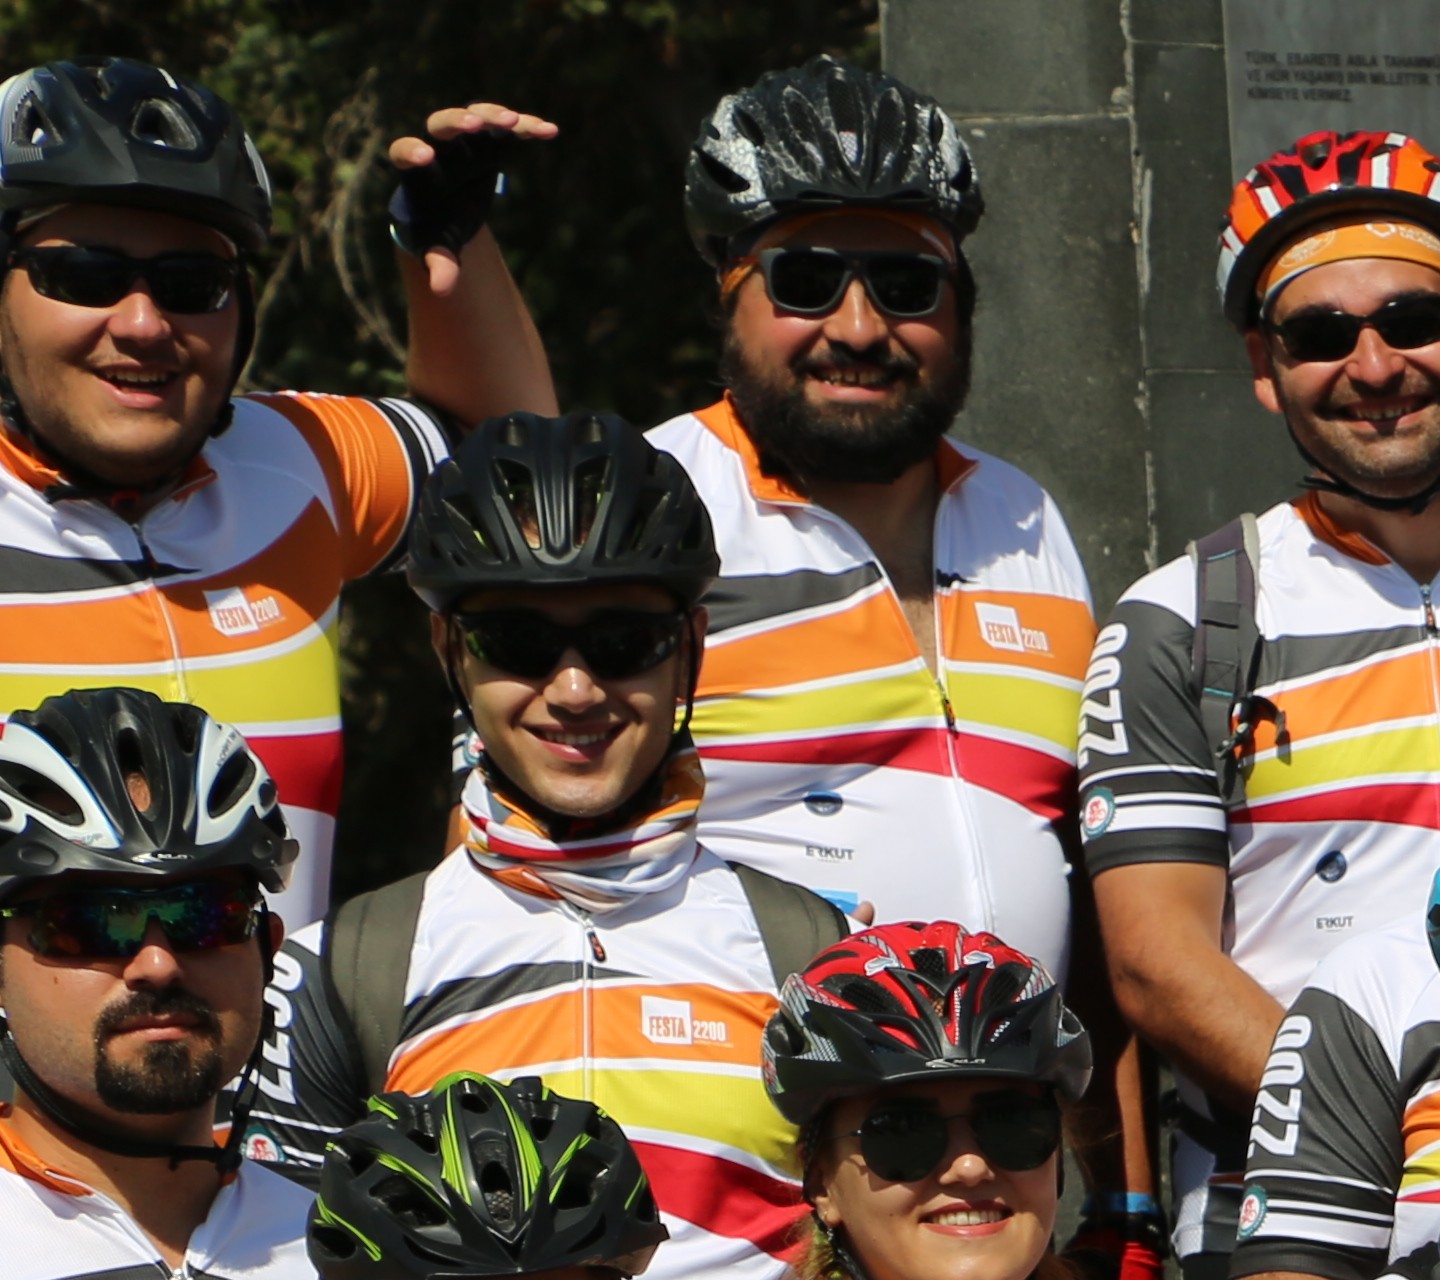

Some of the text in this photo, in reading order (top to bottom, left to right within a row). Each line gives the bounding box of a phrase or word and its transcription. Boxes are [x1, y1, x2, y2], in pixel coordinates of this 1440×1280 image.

[216, 606, 252, 631] FESTA
[986, 621, 1018, 648] FESTA
[802, 842, 857, 862] ERKUT
[648, 1015, 726, 1044] FESTA 2200
